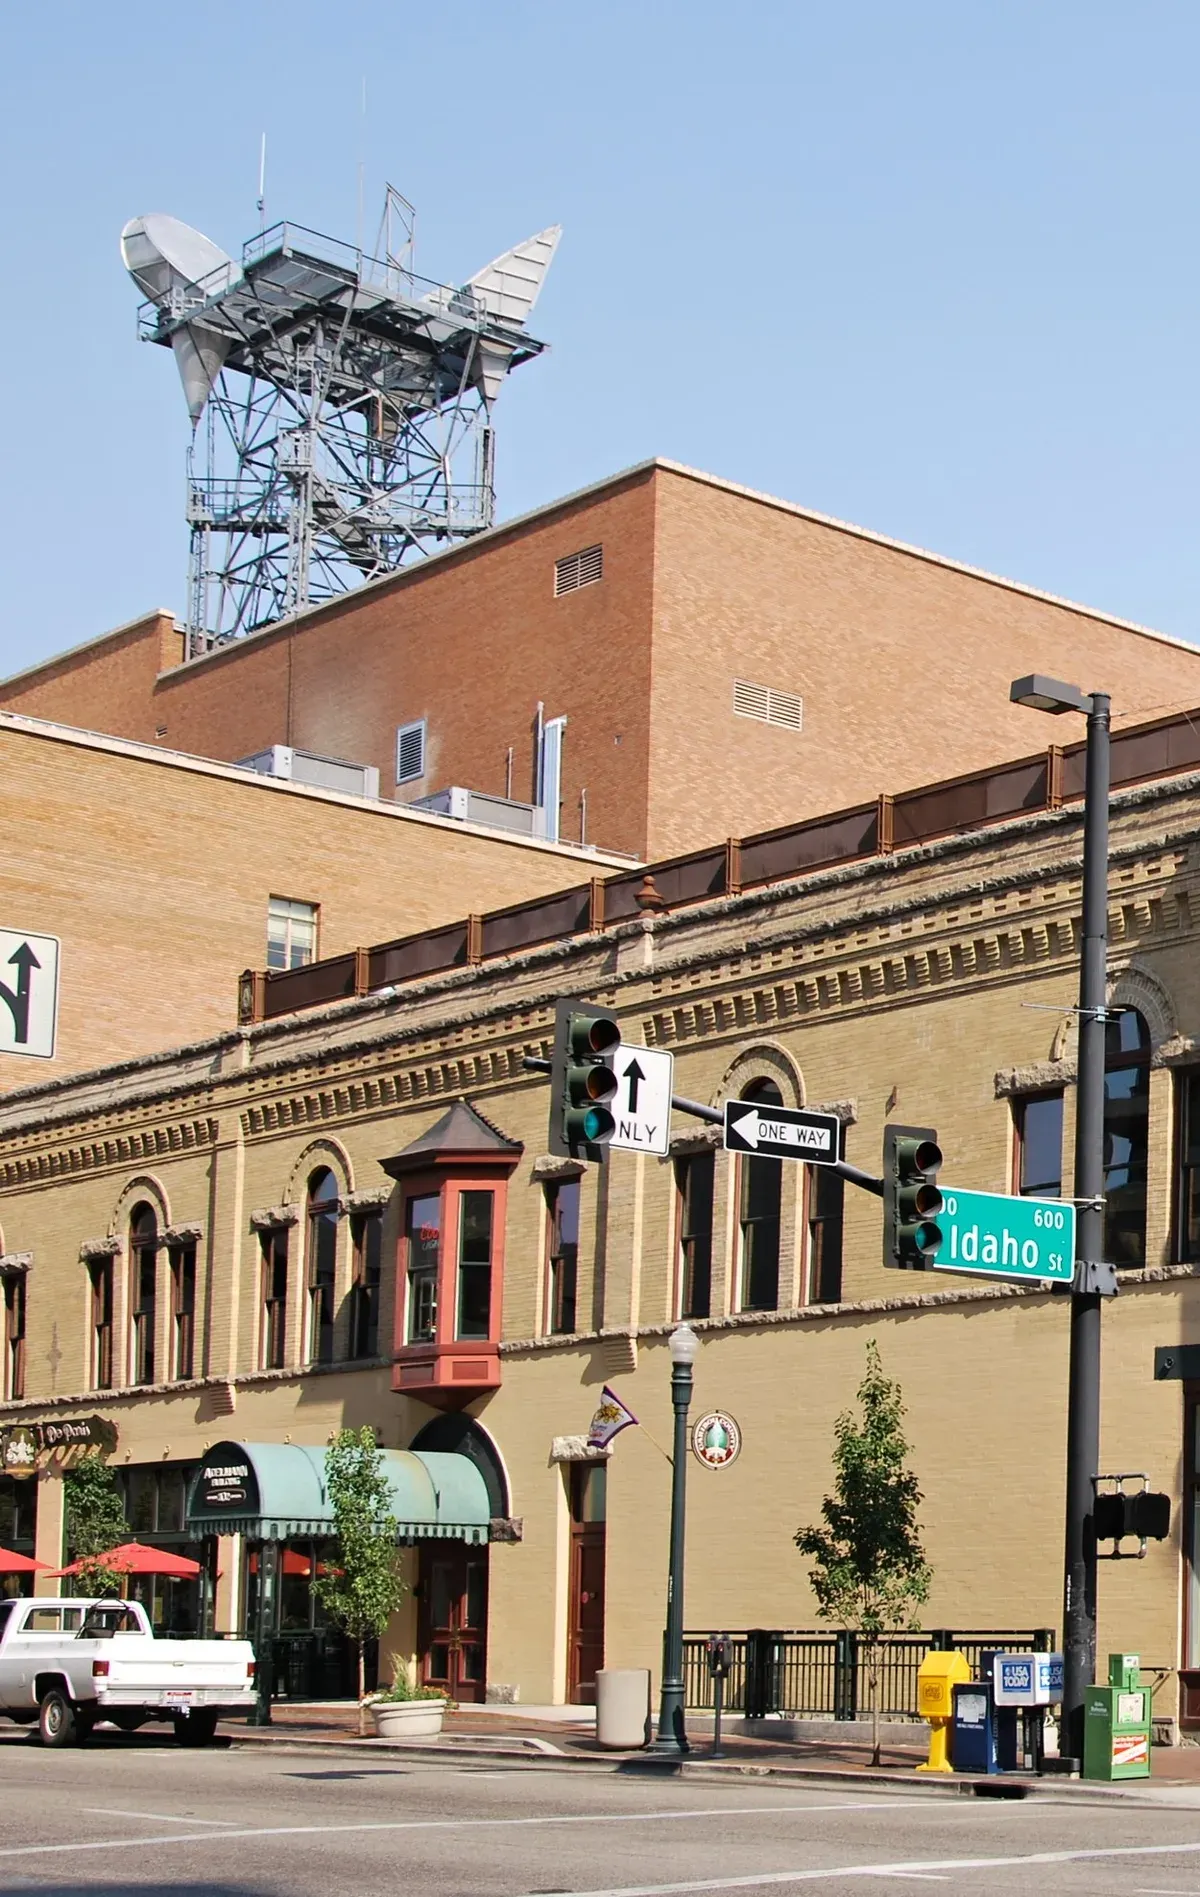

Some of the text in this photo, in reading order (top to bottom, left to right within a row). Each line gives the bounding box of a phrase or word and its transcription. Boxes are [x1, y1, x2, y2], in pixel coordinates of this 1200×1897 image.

[619, 1119, 657, 1143] NLY
[758, 1122, 826, 1146] ONE WAY
[1034, 1209, 1065, 1230] 600
[951, 1224, 1063, 1272] Idaho St
[1003, 1676, 1030, 1687] TODAY
[1011, 1666, 1029, 1677] USA
